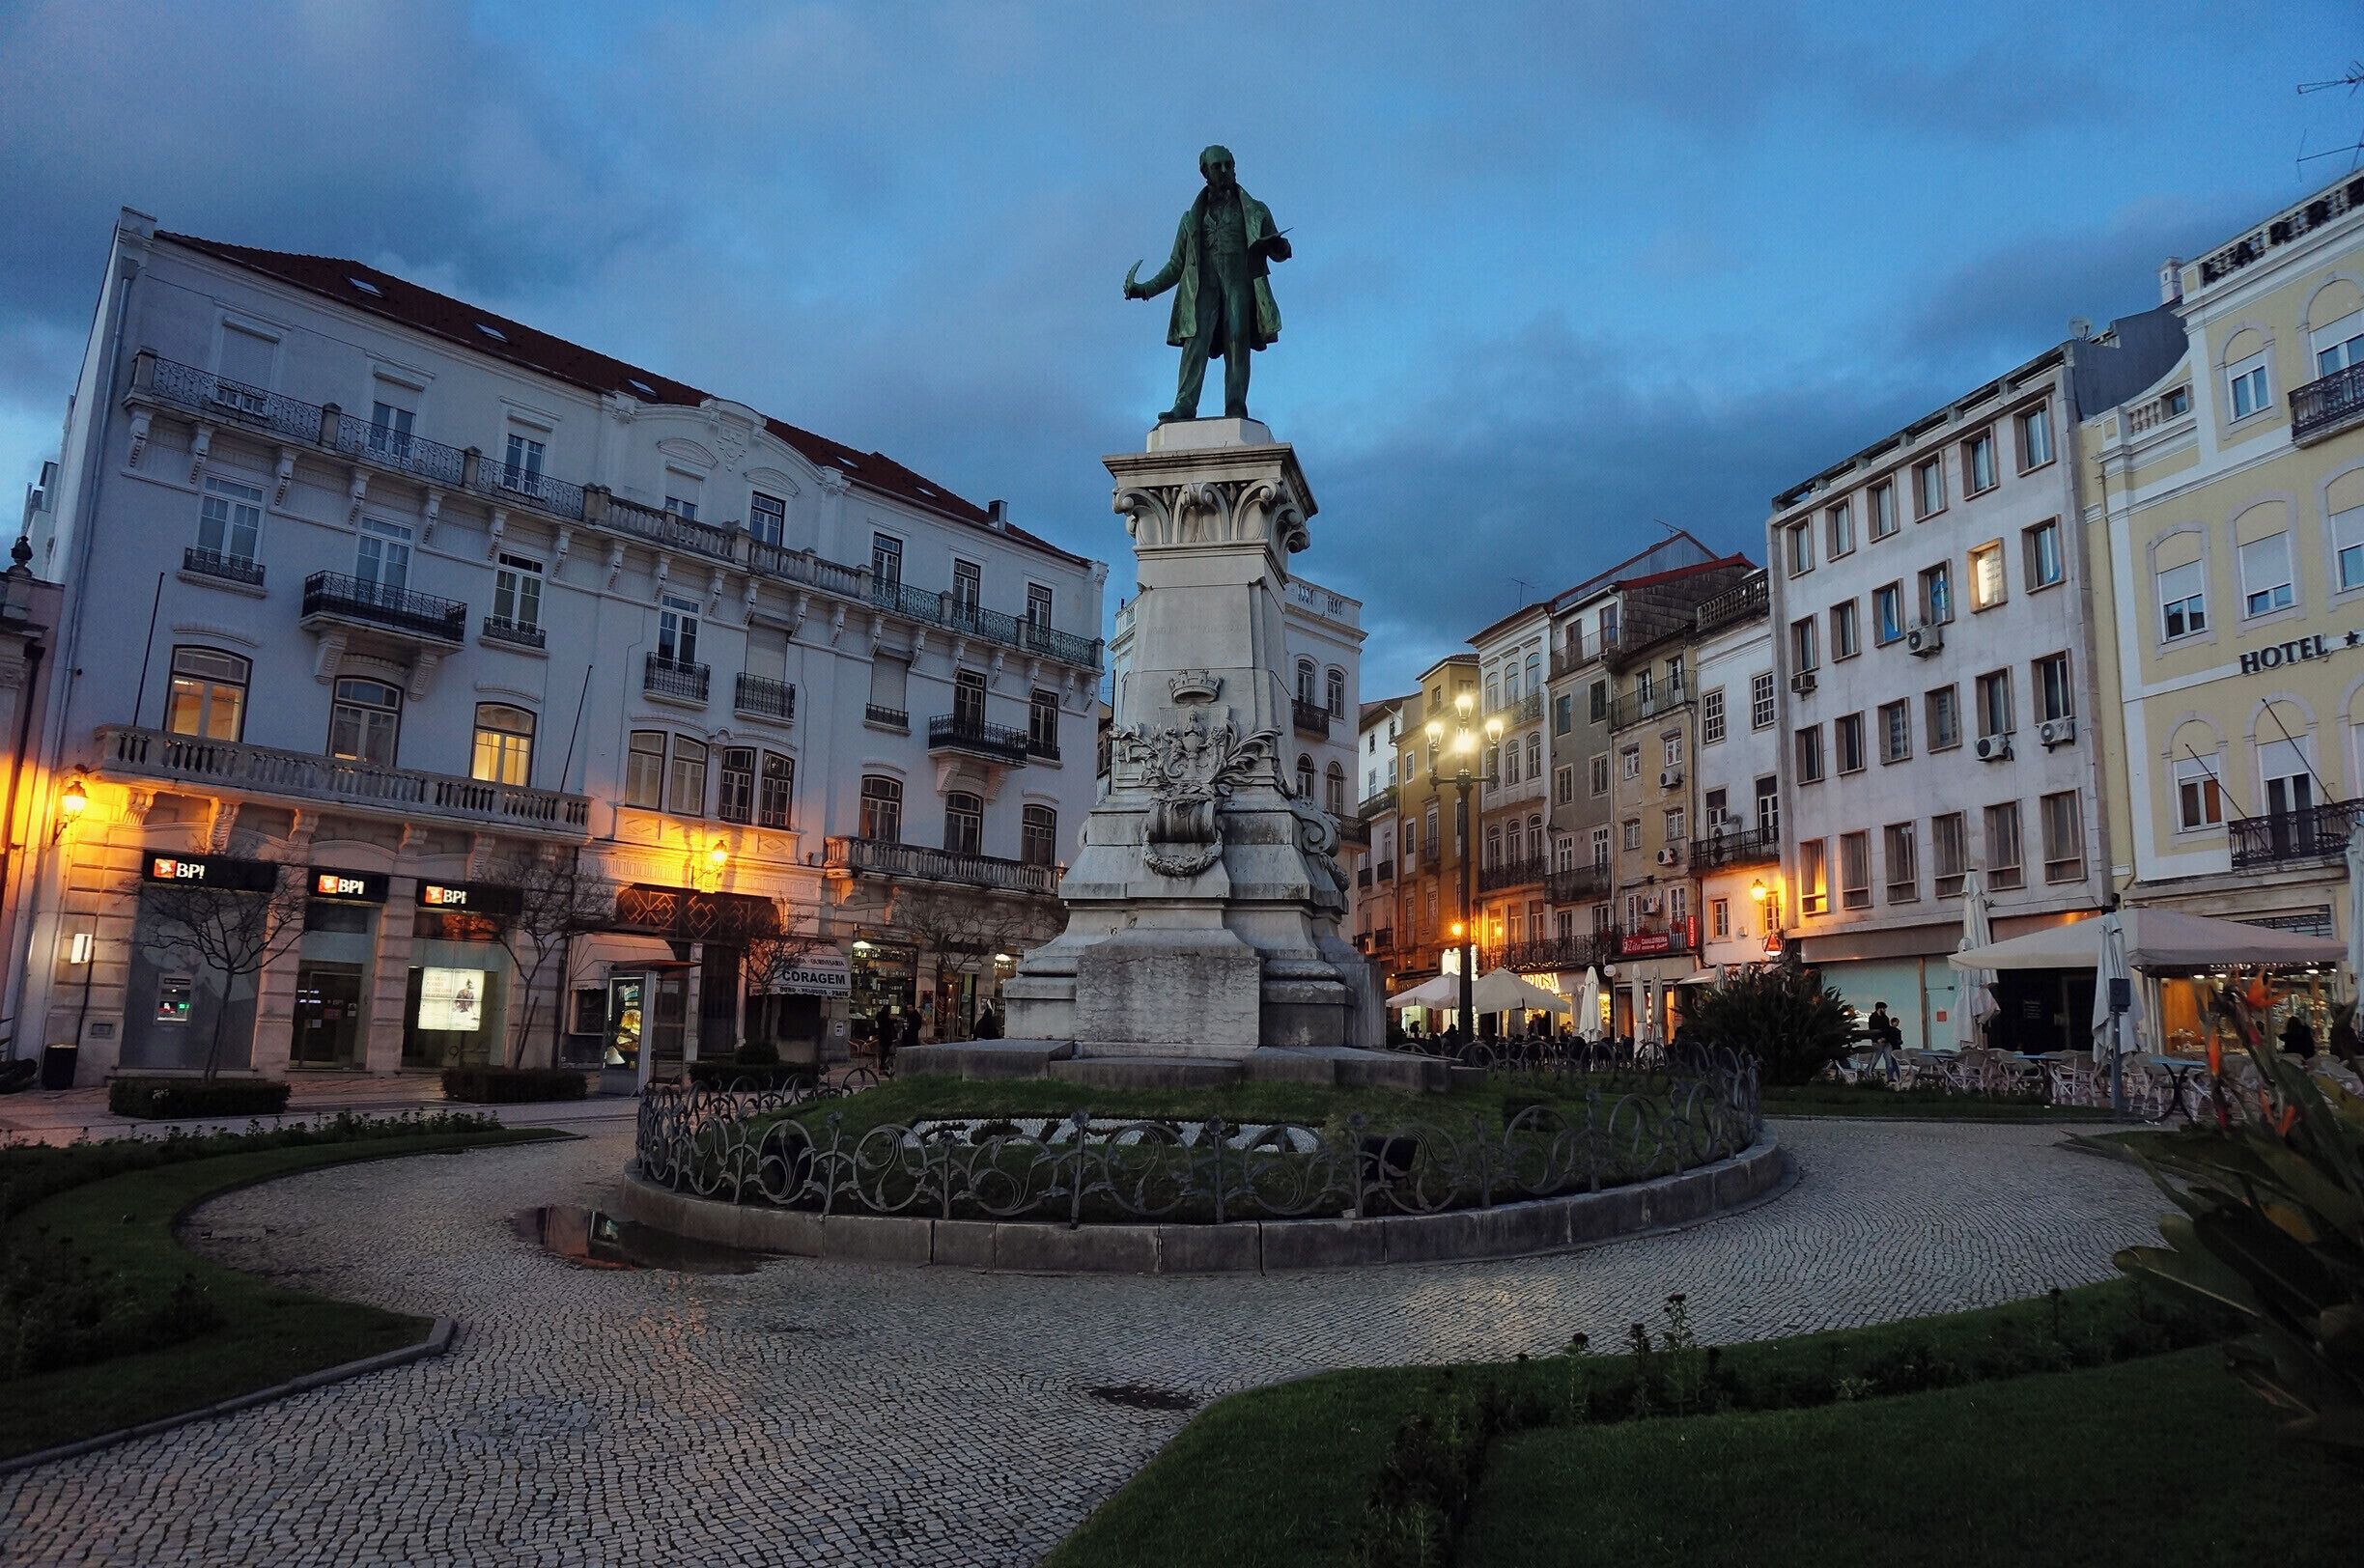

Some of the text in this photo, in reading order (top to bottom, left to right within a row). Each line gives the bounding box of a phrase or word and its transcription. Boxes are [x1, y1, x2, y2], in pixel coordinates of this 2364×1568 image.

[2239, 634, 2329, 675] HOTEL
[176, 862, 206, 880] BPI
[338, 879, 365, 895] BPI
[442, 889, 467, 905] BPI
[782, 968, 846, 985] CORAGEM
